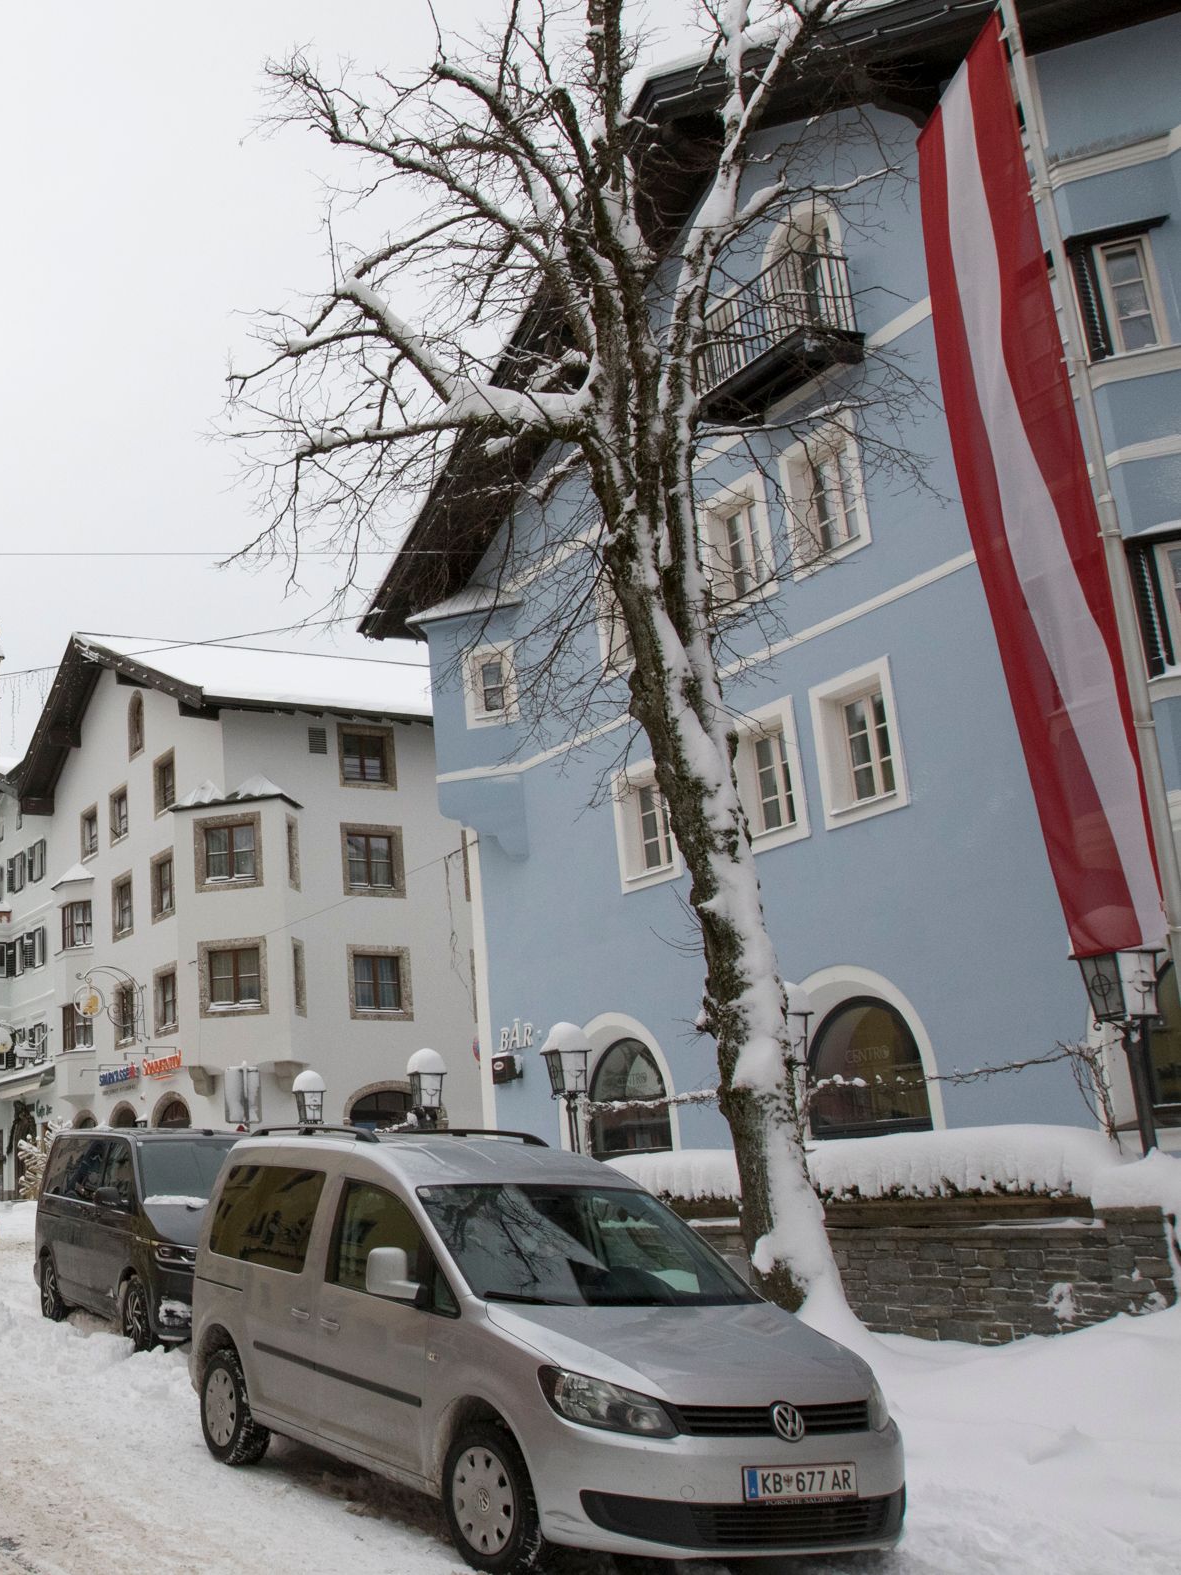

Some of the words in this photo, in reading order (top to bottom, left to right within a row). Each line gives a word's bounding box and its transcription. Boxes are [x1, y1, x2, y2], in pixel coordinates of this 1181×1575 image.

[499, 1021, 533, 1052] BAR
[761, 1472, 784, 1495] KB
[796, 1470, 826, 1493] 677
[831, 1469, 852, 1491] AR
